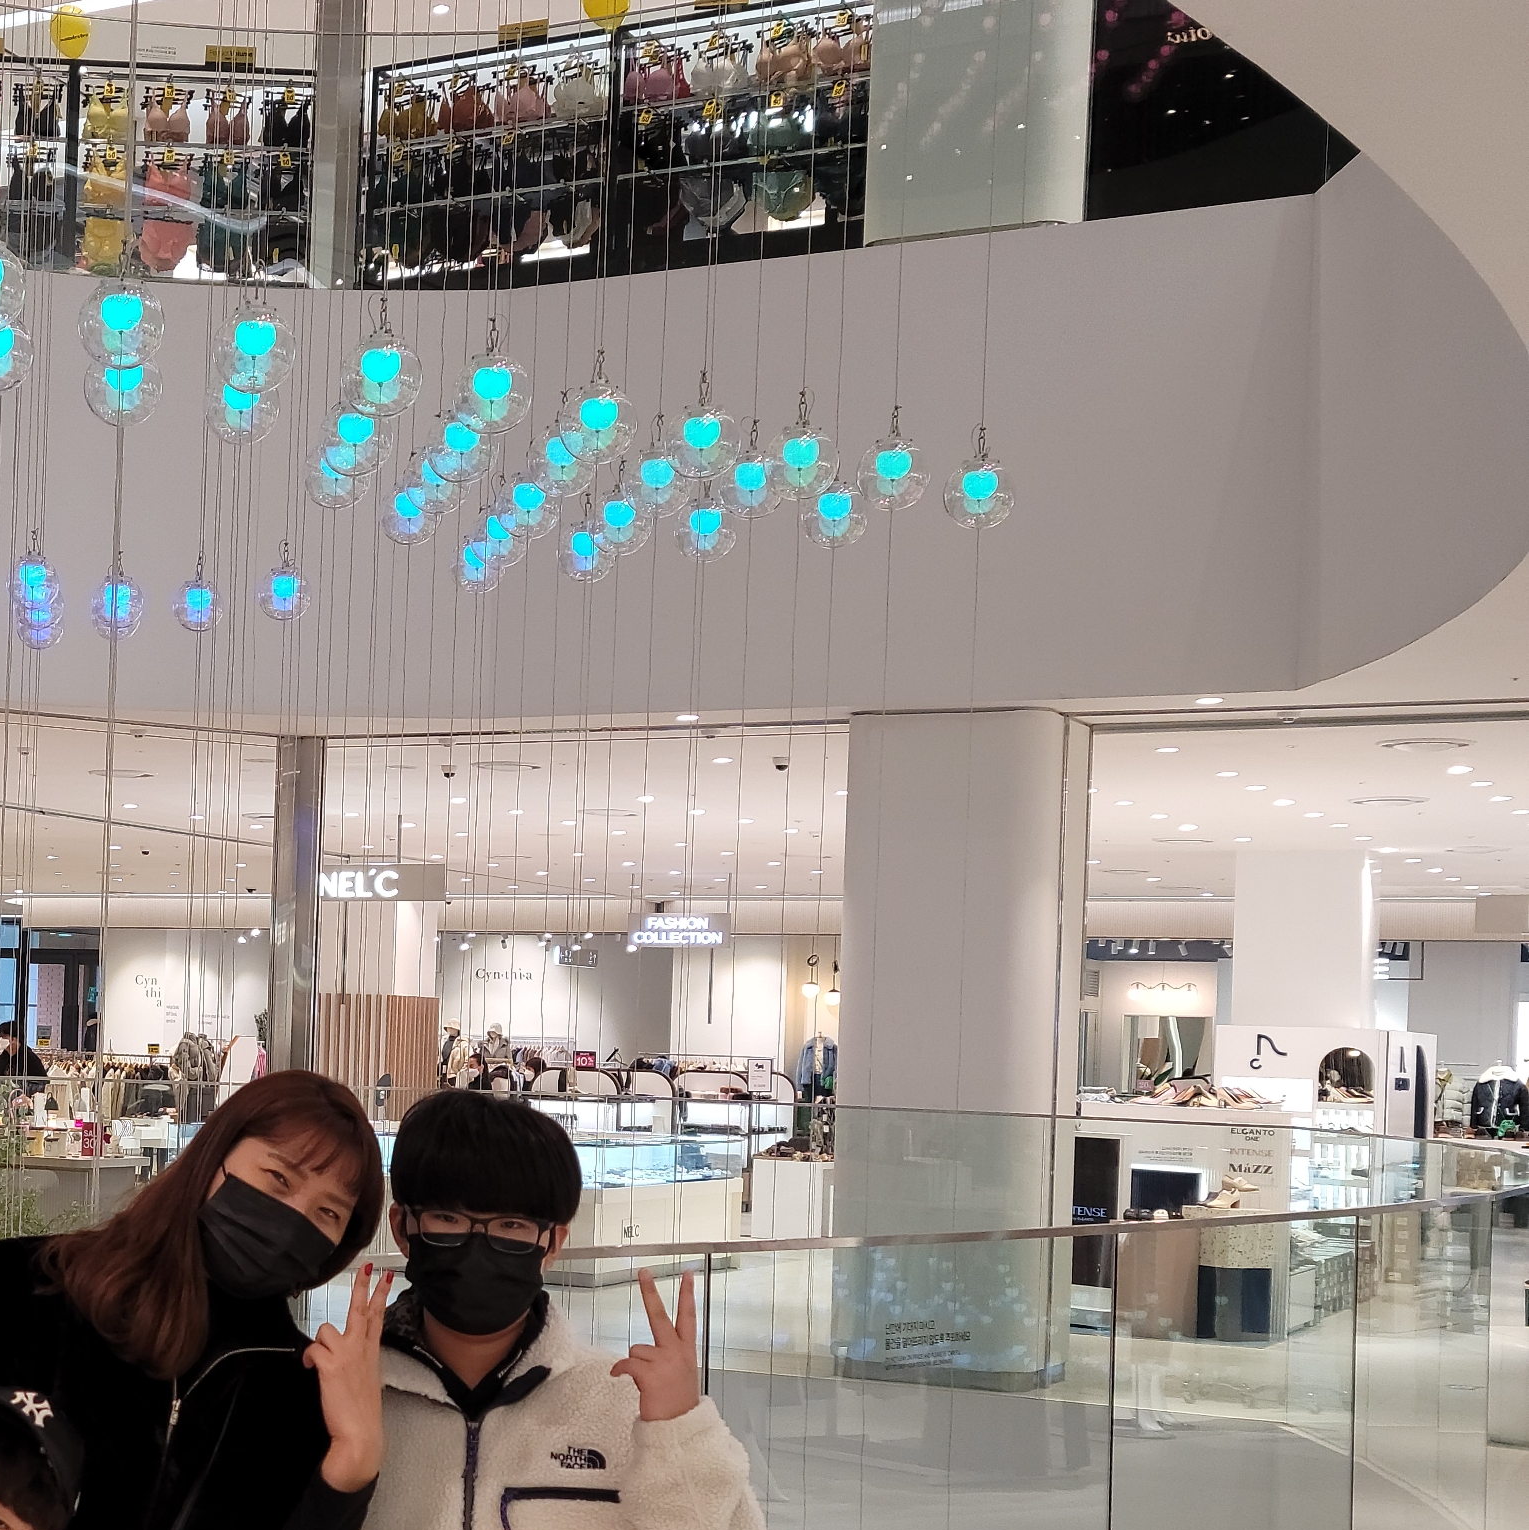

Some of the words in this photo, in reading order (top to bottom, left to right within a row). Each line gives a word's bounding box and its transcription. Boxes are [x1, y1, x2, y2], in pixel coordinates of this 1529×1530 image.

[646, 916, 710, 930] FASHION
[633, 931, 723, 945] COLLECTION
[135, 974, 158, 989] Cyn
[550, 1451, 587, 1463] NORTH
[567, 1446, 587, 1456] THE
[560, 1461, 587, 1470] FACE
